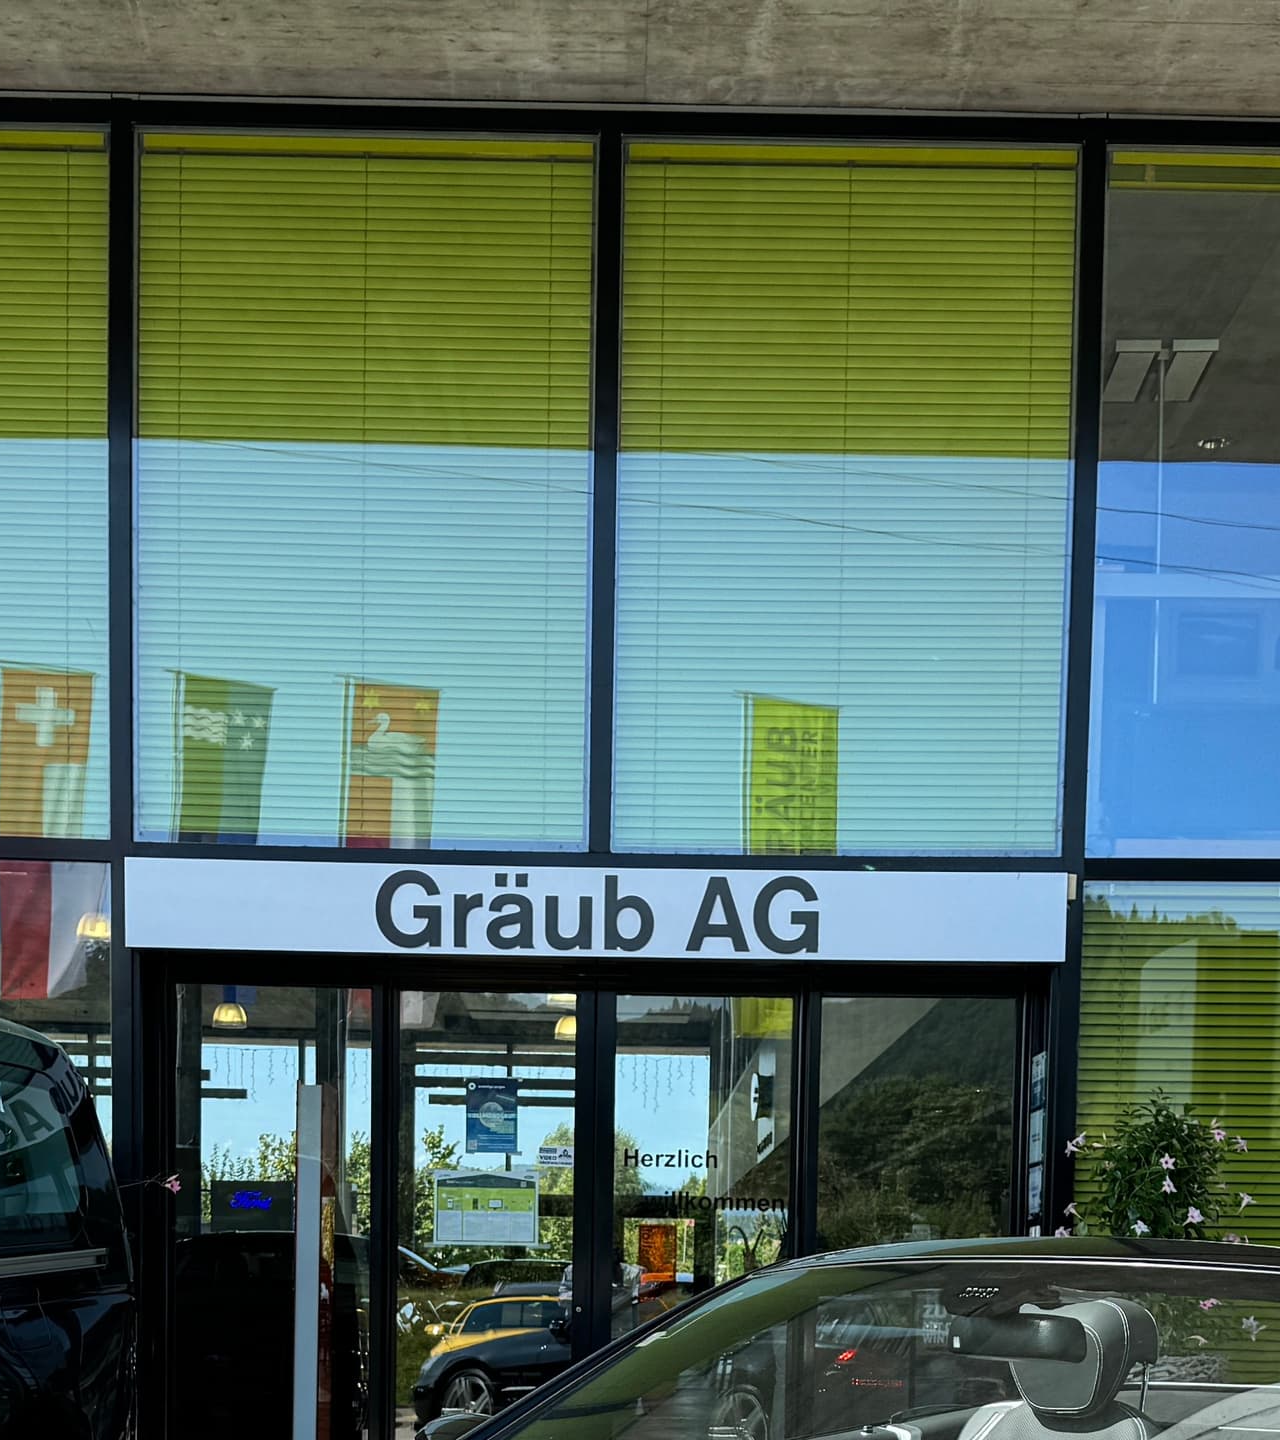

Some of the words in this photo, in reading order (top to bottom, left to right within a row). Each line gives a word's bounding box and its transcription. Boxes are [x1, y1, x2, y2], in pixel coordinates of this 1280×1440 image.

[375, 869, 654, 953] Gräub
[685, 875, 820, 954] AG
[623, 1147, 718, 1169] Herzlich
[645, 1191, 785, 1212] willkommen
